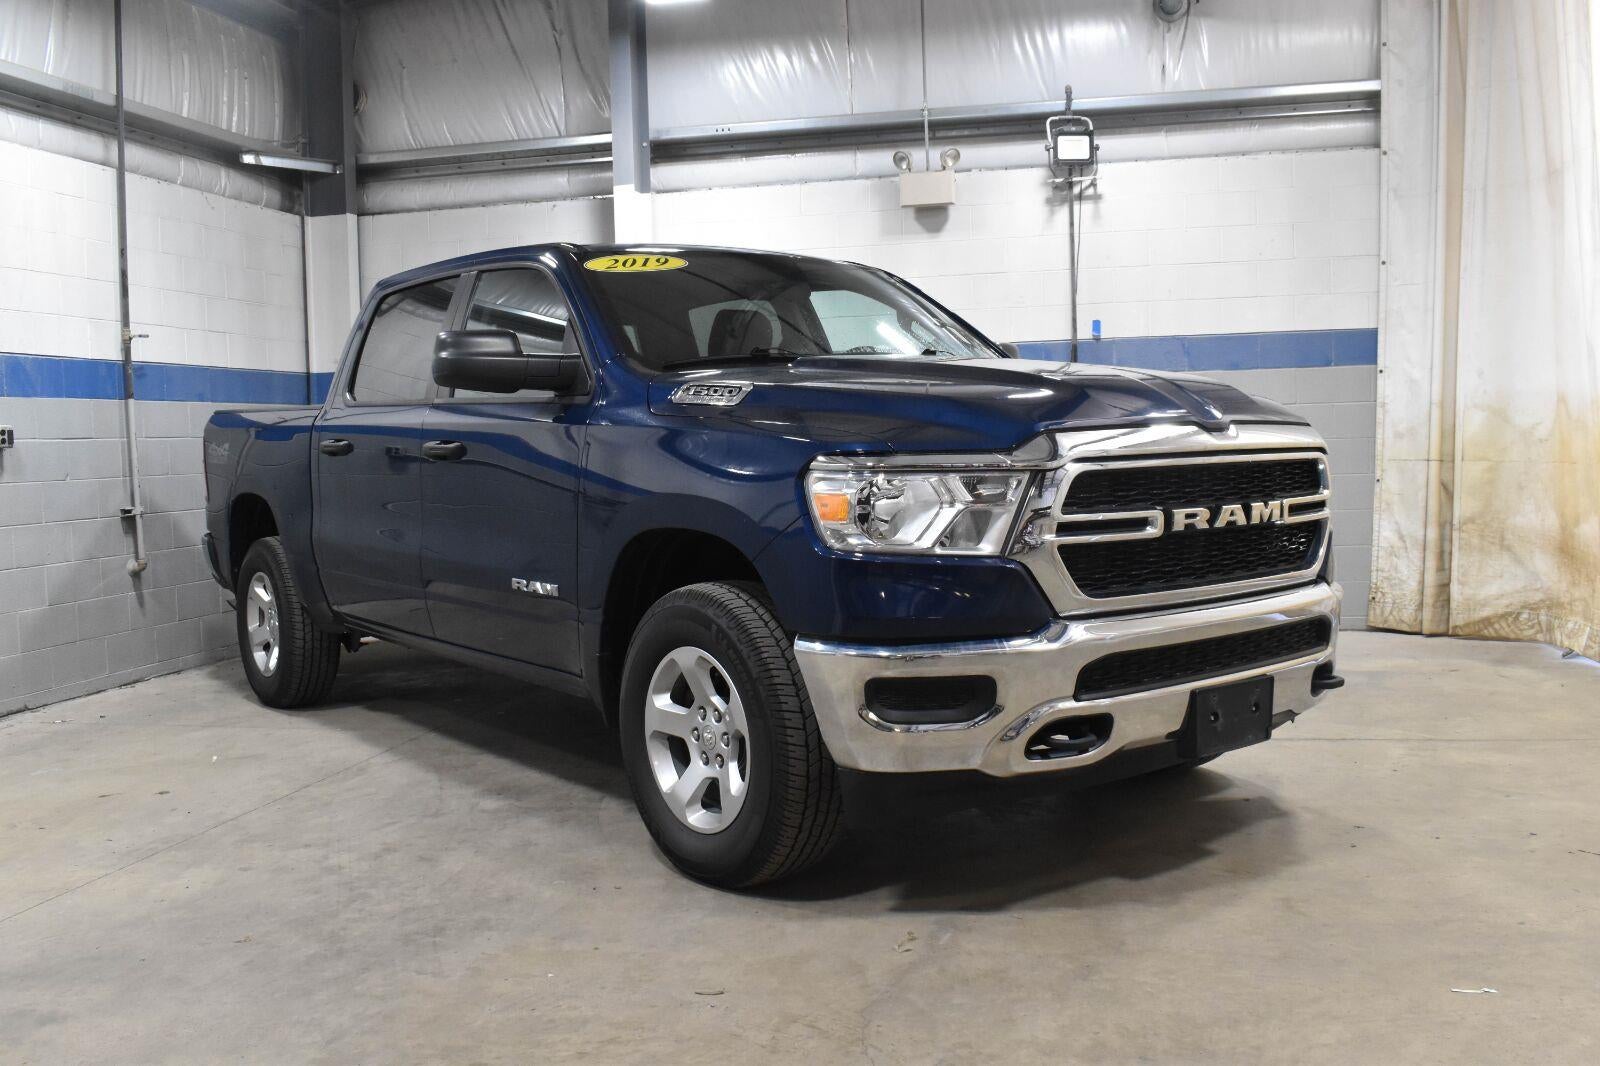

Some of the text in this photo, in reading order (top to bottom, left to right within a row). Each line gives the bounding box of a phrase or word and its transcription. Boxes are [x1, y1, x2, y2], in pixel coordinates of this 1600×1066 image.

[605, 257, 670, 270] 2019
[688, 386, 740, 397] 1500
[1171, 500, 1281, 532] RAM
[511, 577, 559, 597] RAM
